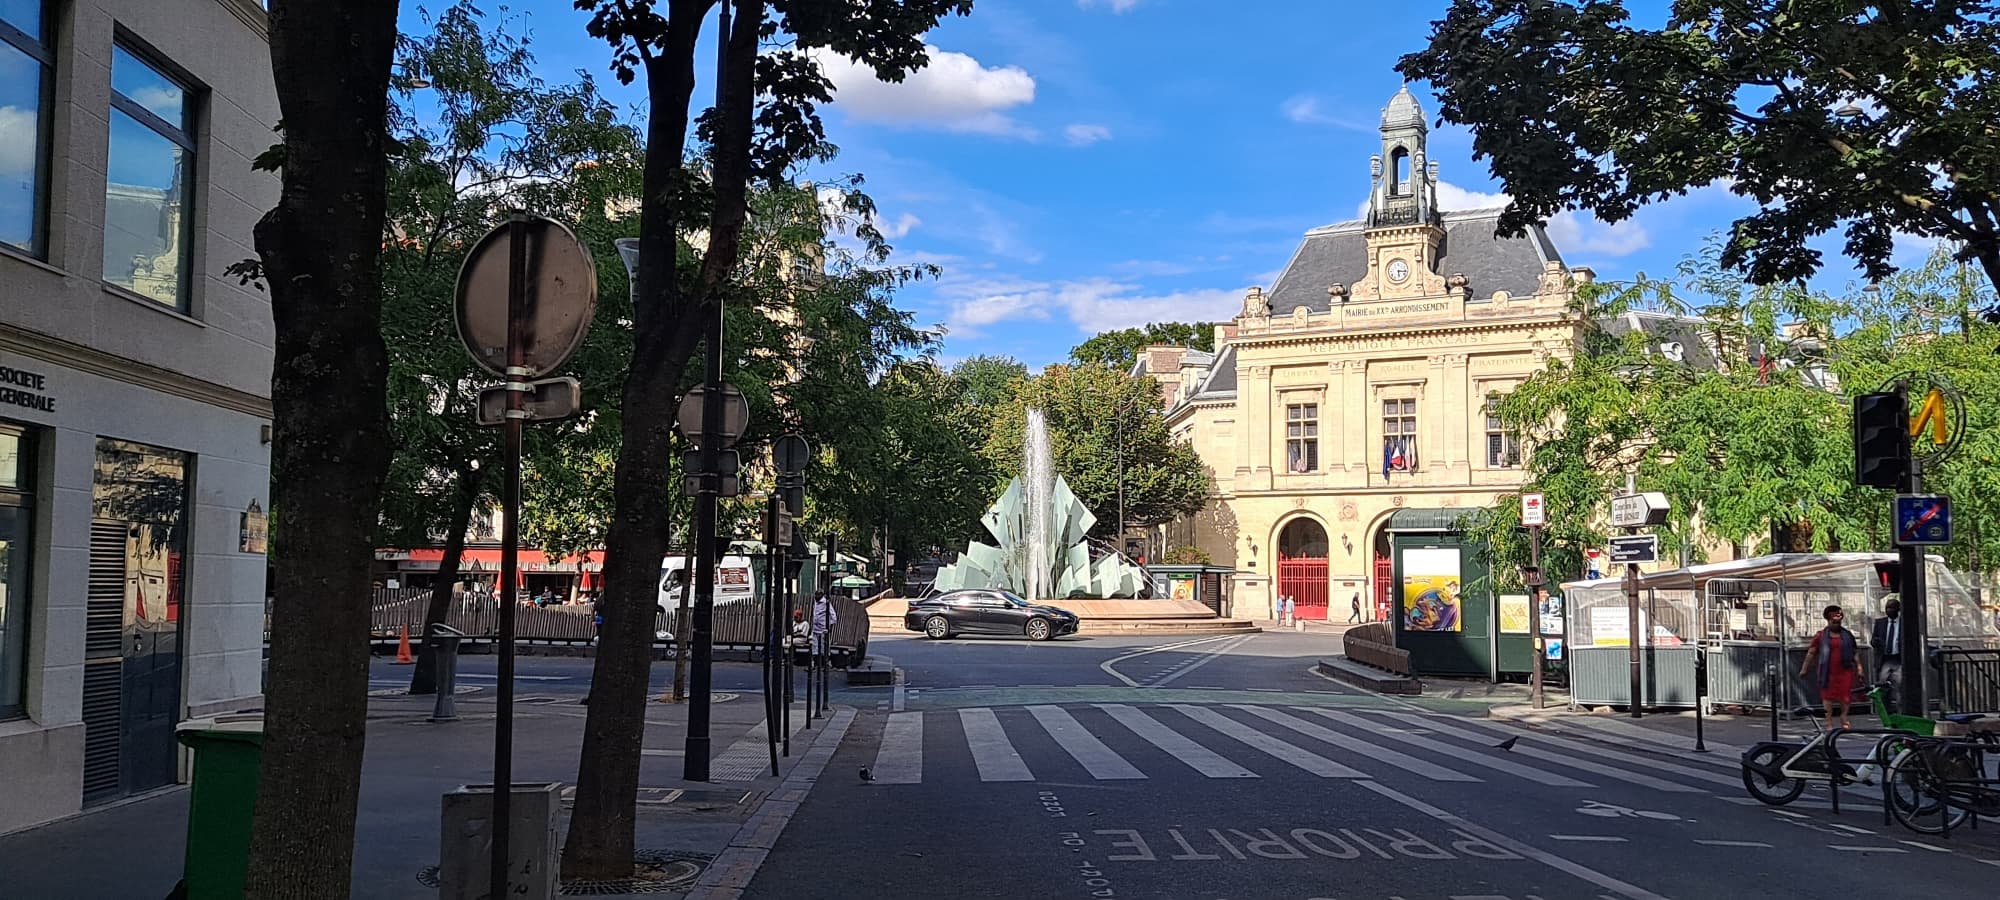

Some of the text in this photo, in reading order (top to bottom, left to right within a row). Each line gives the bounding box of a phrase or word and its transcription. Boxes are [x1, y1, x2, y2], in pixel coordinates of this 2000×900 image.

[1345, 308, 1368, 317] MAIRIE
[1390, 302, 1449, 314] ARRONDISSEMENT
[0, 366, 45, 390] SOCIETE
[0, 387, 56, 412] GENERALE
[1094, 828, 1526, 860] PRIORITE
